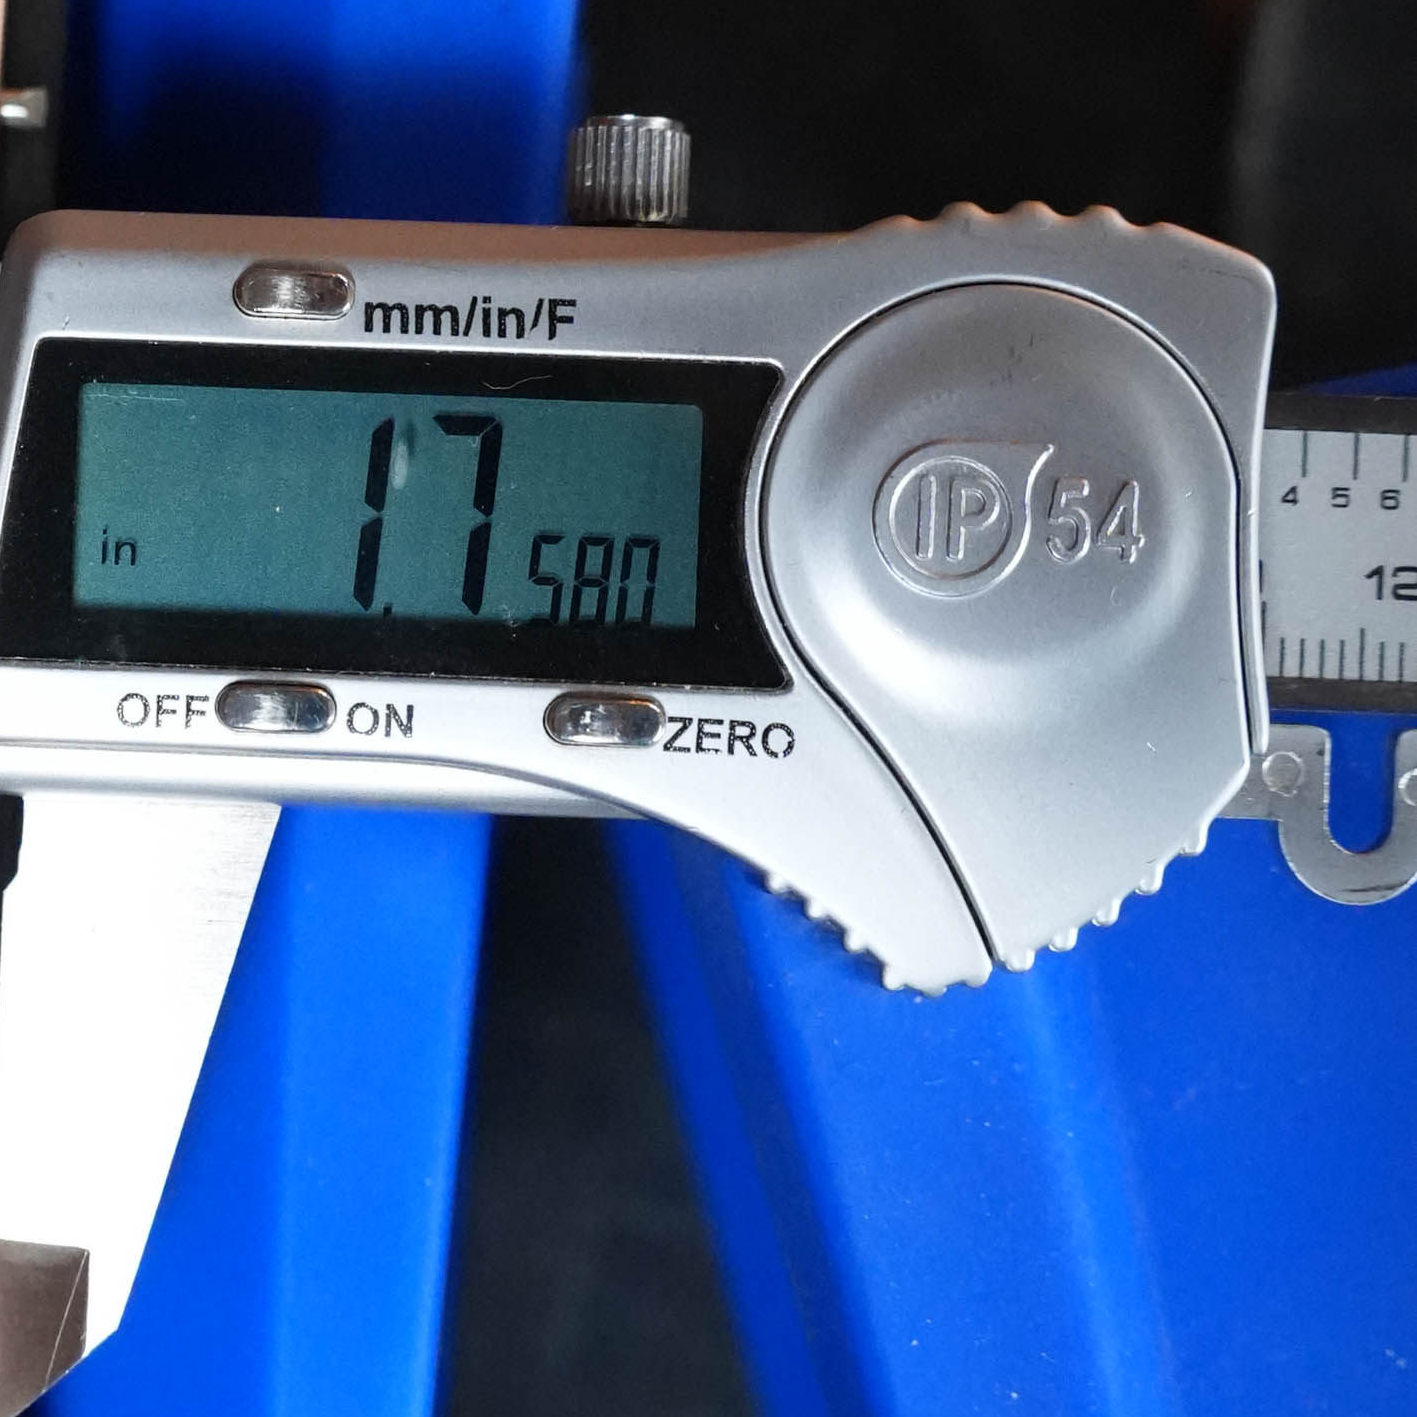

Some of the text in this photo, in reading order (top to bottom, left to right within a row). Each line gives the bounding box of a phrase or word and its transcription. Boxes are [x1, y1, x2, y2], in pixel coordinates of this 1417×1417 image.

[364, 295, 577, 341] mm/in/F
[1281, 485, 1401, 511] 4 5 6
[913, 475, 1147, 565] IP 54
[101, 527, 138, 566] in
[116, 692, 210, 728] OFF
[346, 701, 415, 738] ON
[662, 715, 796, 760] ZERO
